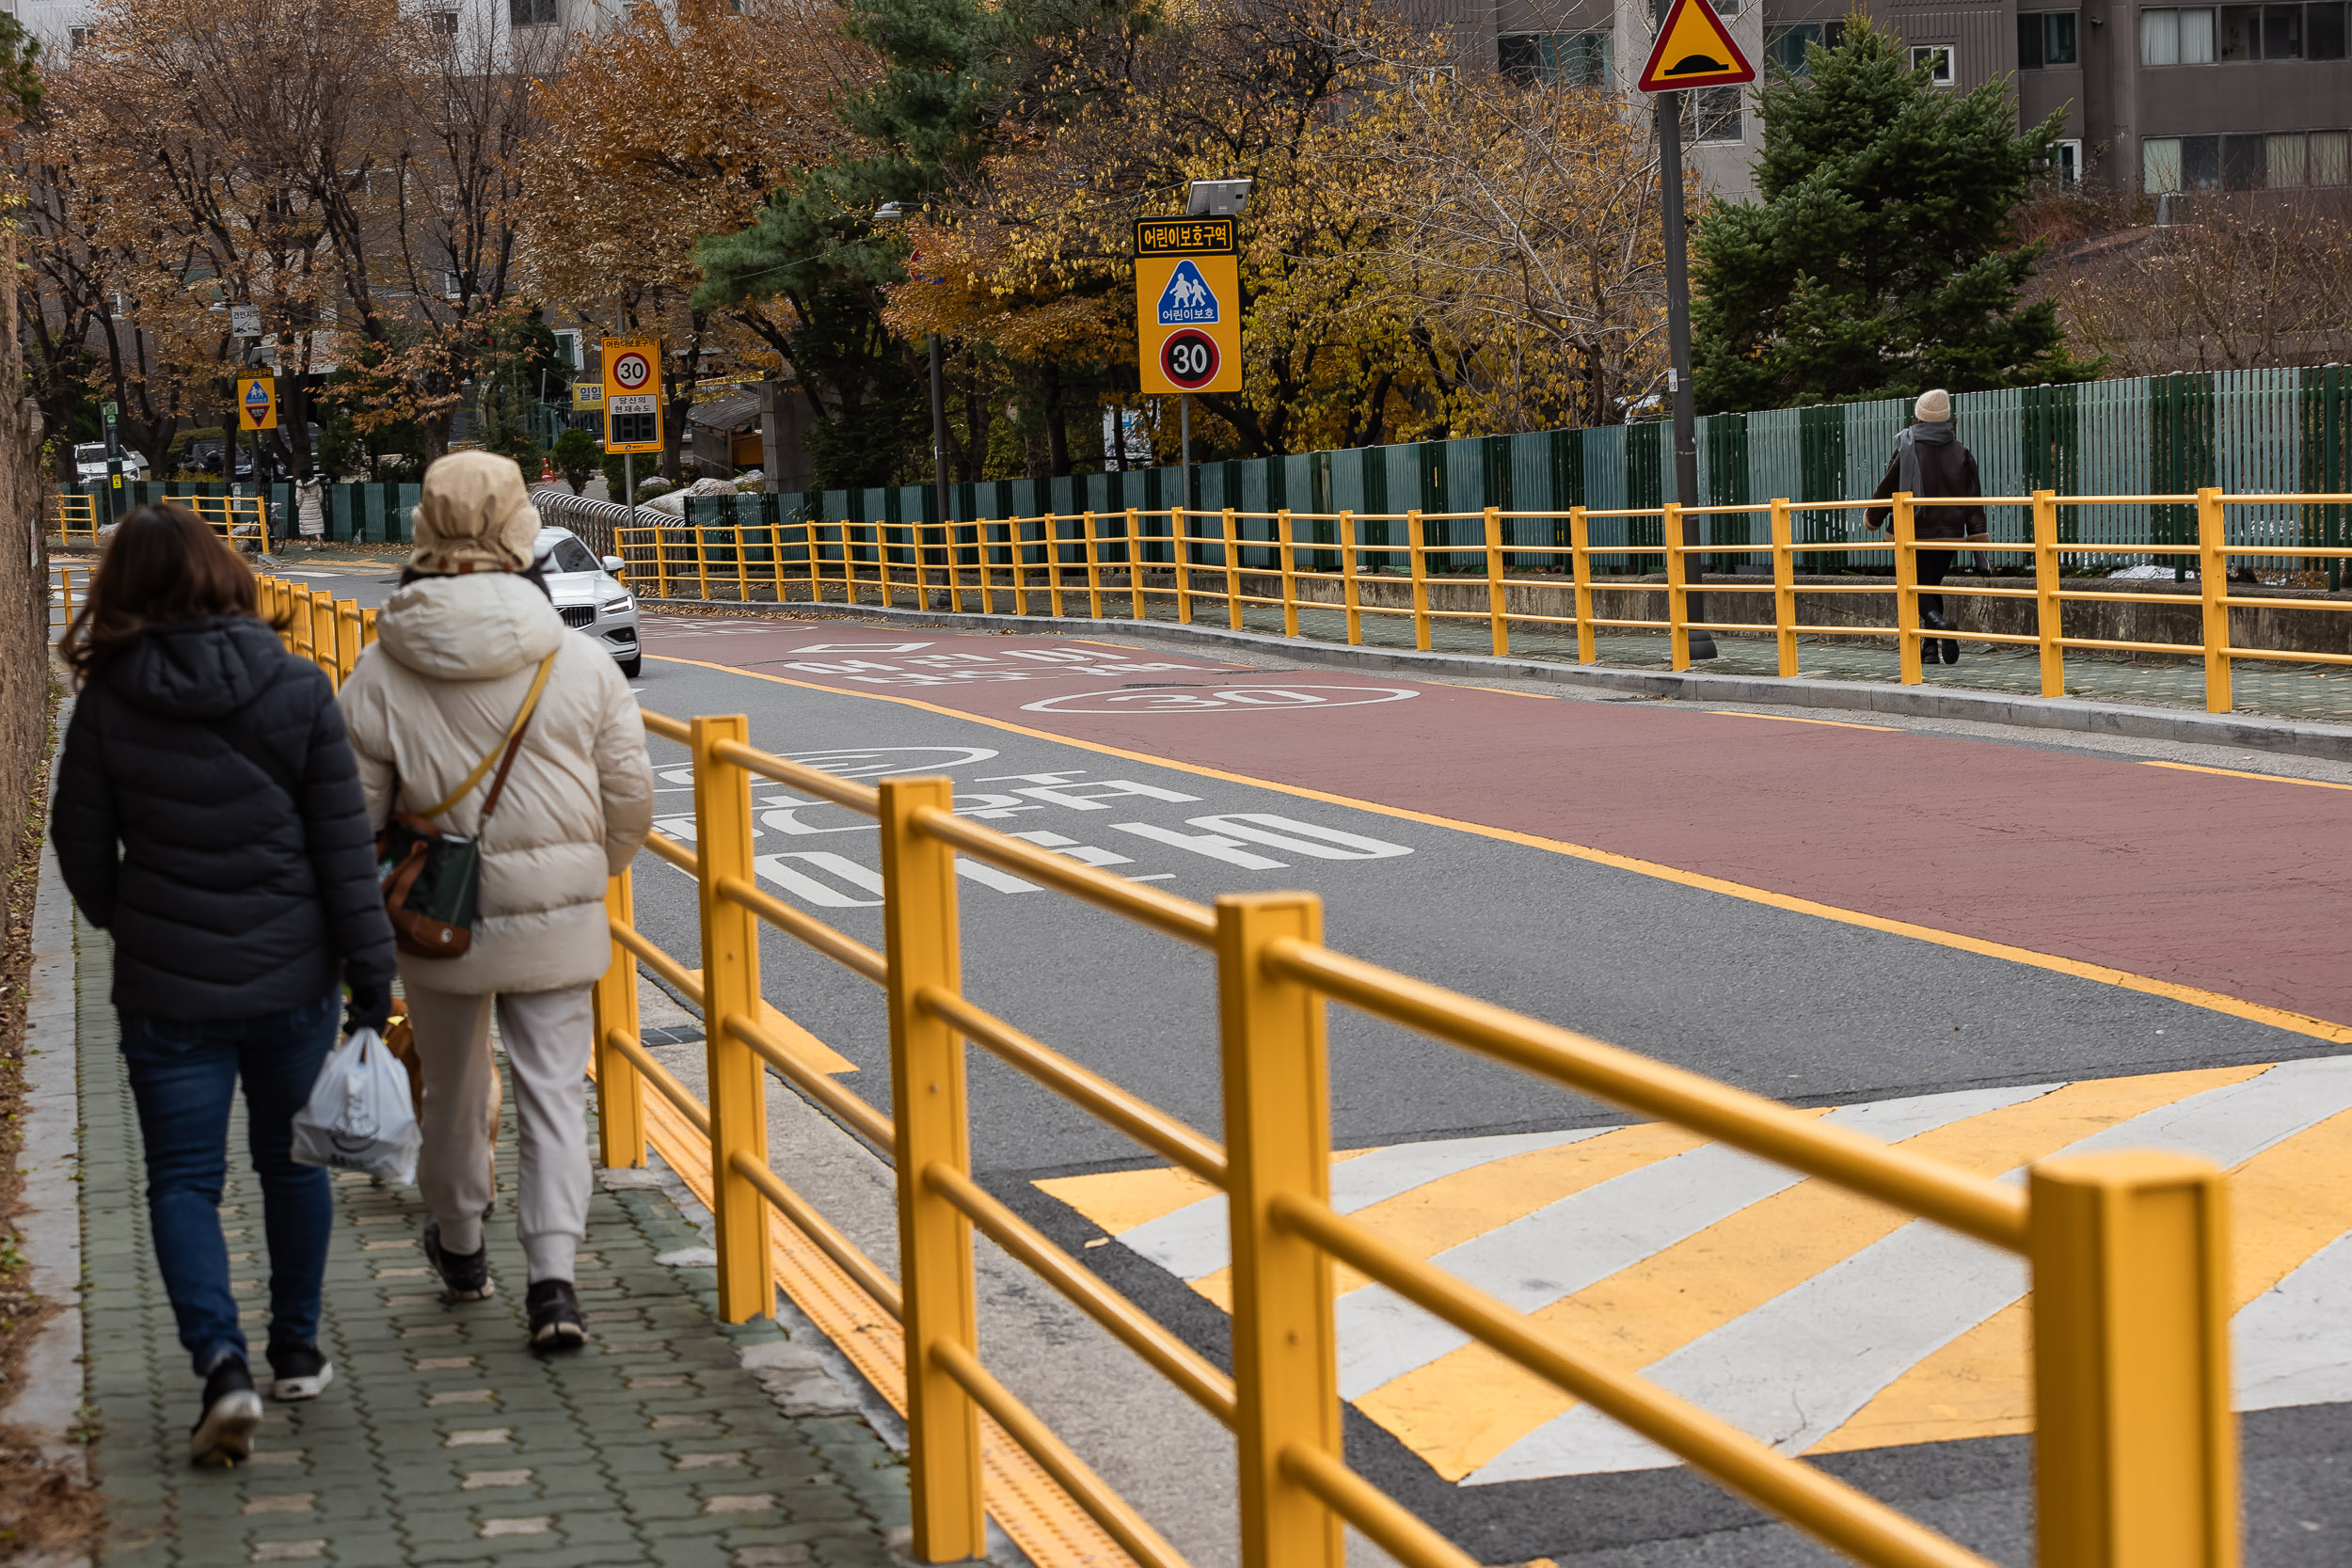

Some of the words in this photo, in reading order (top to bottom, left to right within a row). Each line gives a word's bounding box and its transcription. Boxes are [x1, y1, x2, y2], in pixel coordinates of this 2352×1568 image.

[1144, 225, 1226, 247] 어린이보호구역
[1162, 309, 1216, 322] 어린이보호
[1172, 343, 1208, 374] 30
[620, 362, 644, 379] 30
[614, 404, 652, 414] 현재속도
[618, 396, 646, 404] 당신의
[783, 648, 1131, 674] 어린이
[843, 662, 1233, 688] 보호구역
[1106, 689, 1328, 709] 30
